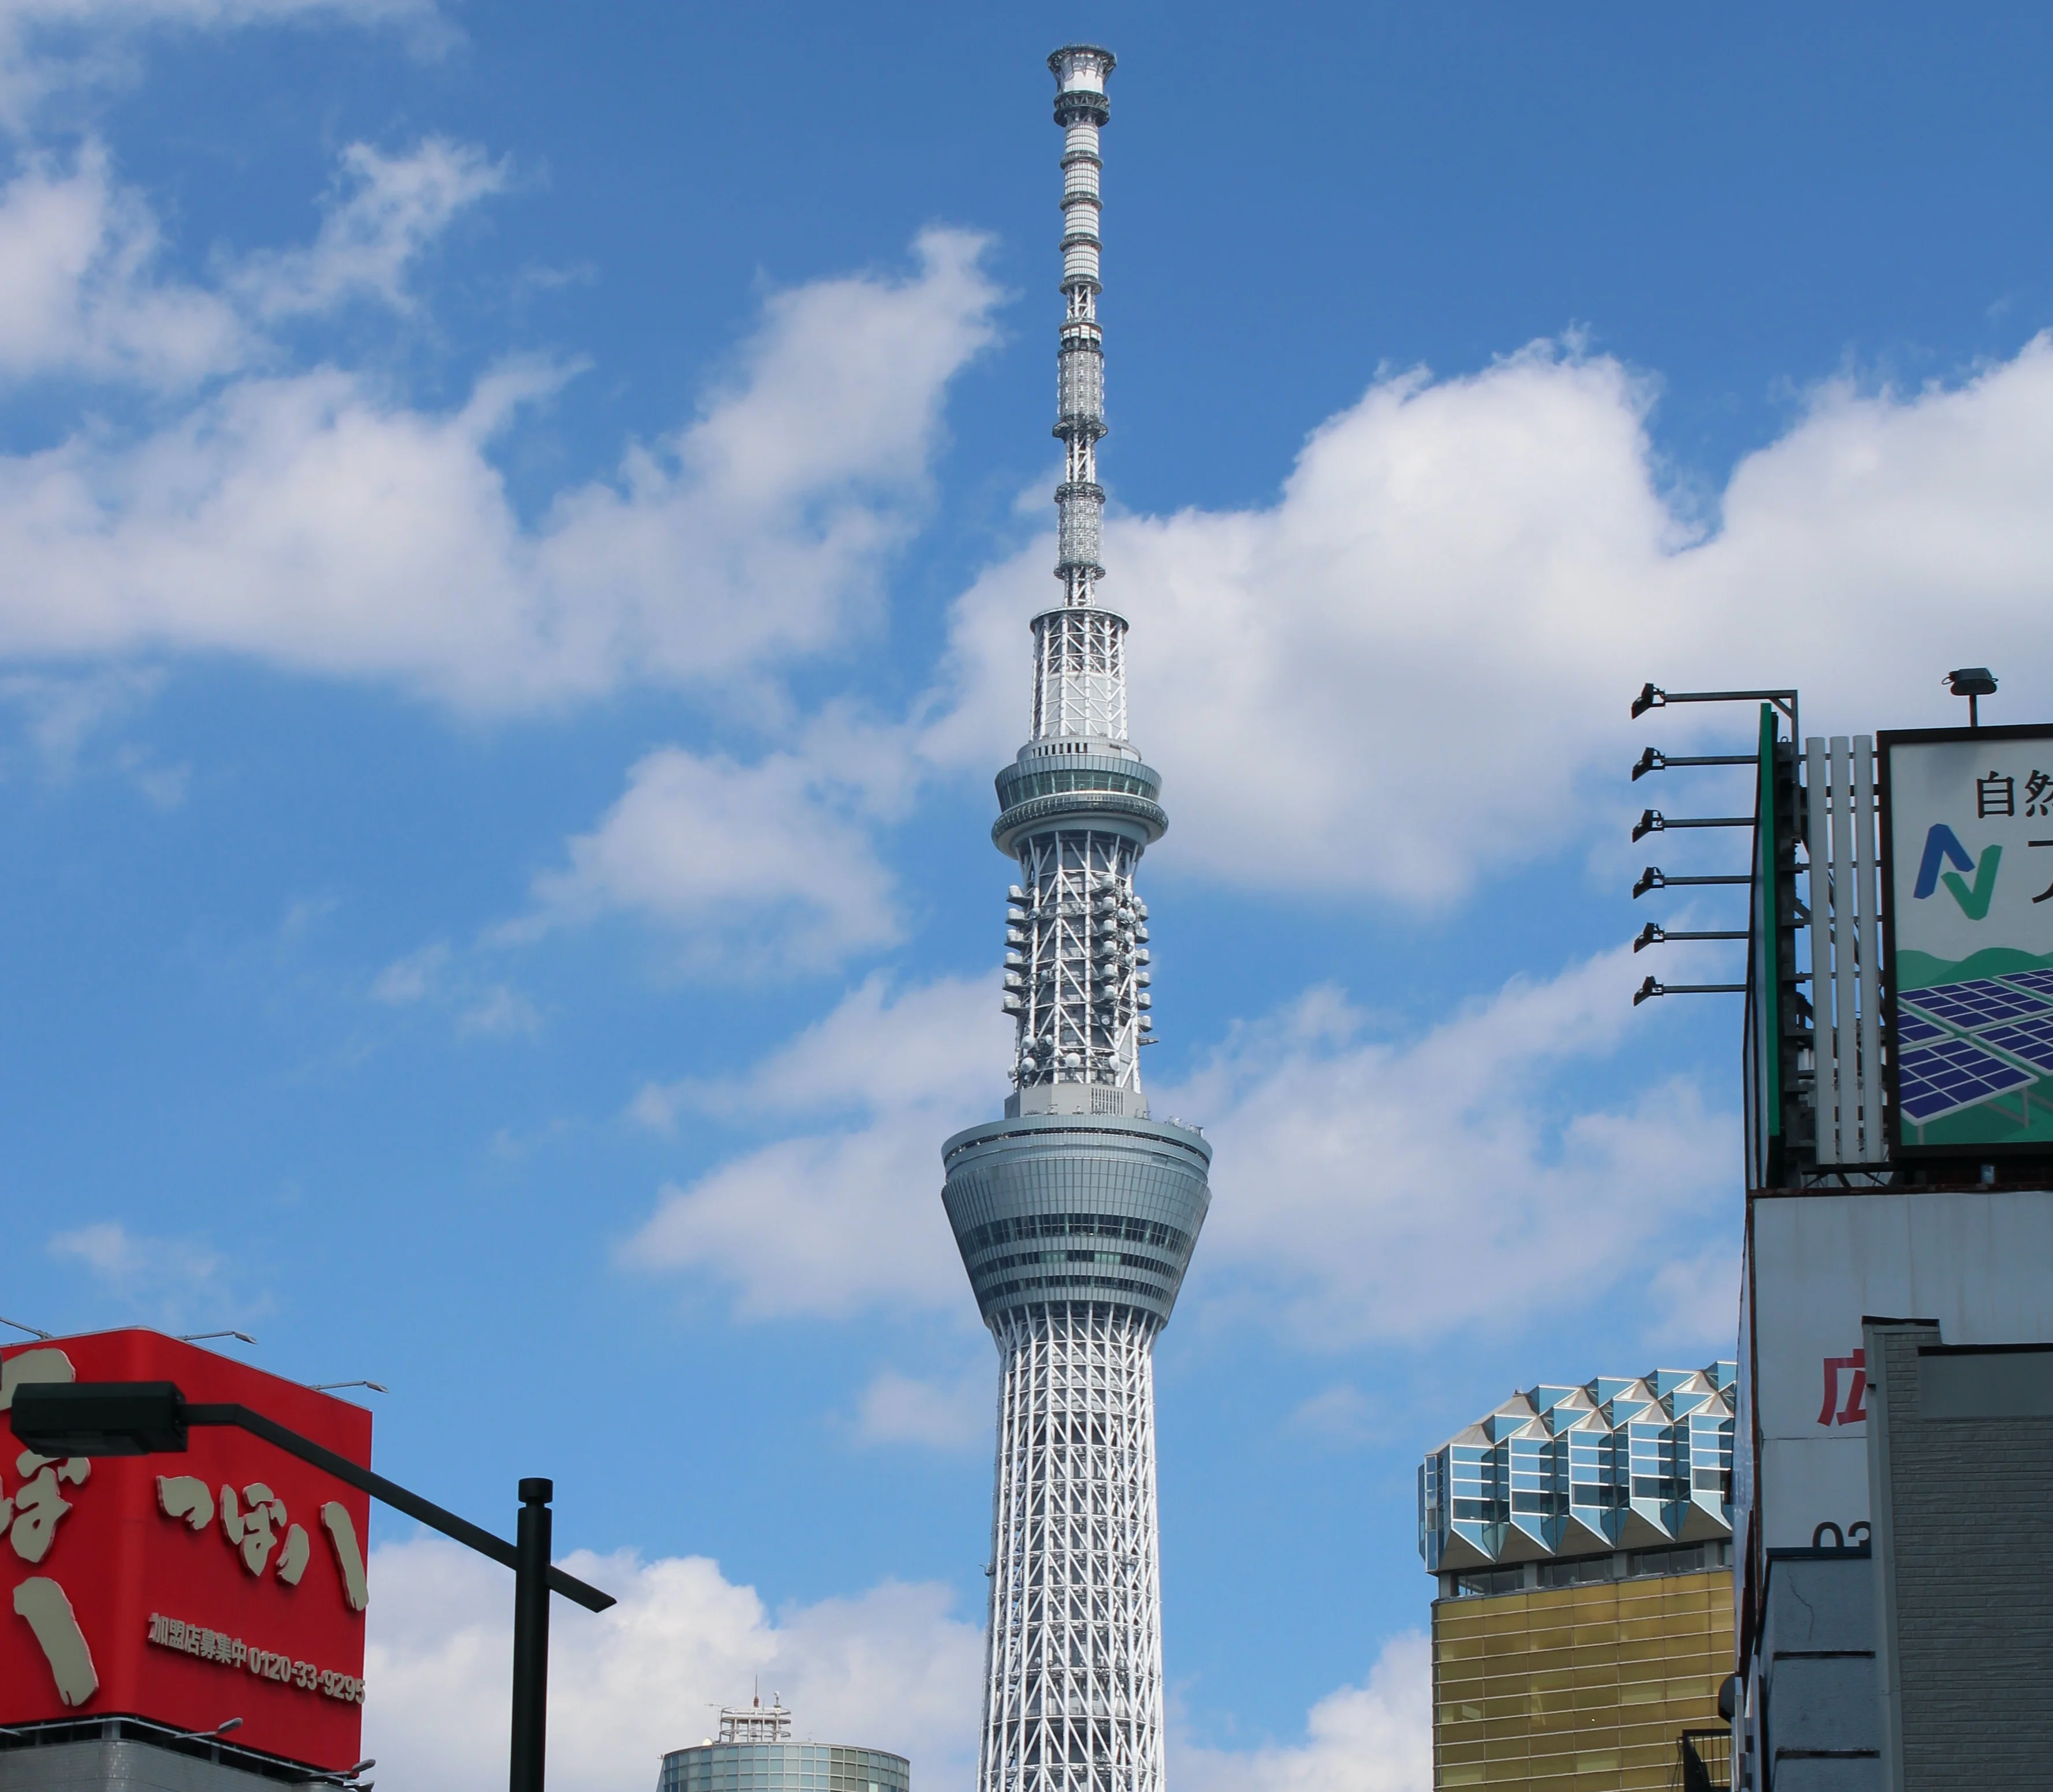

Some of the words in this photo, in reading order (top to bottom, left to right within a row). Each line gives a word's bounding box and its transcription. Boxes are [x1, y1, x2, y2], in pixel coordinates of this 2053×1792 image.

[148, 1612, 247, 1668] 加盟店募集中
[247, 1647, 366, 1704] 0120-33-9295
